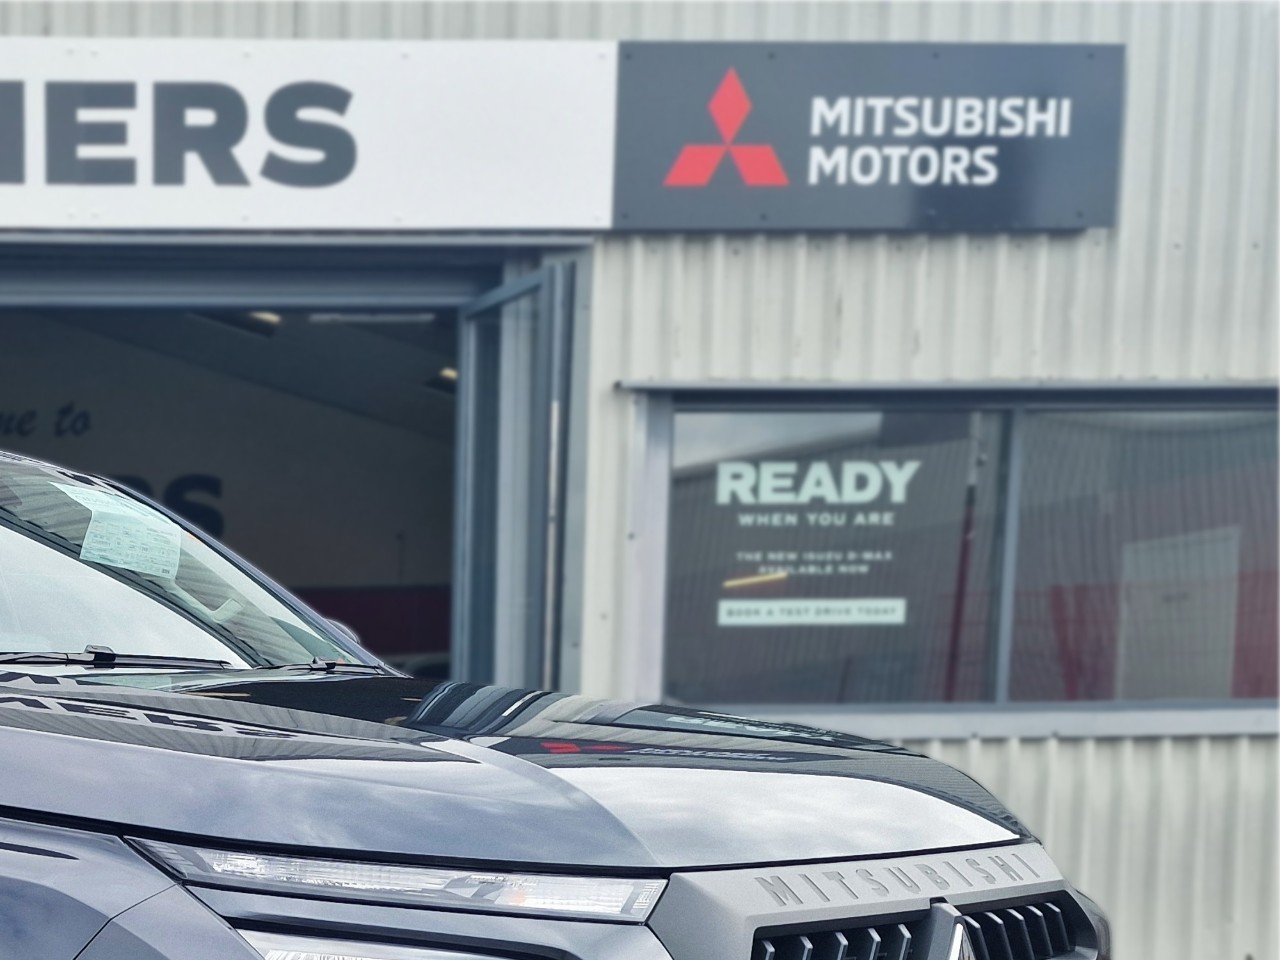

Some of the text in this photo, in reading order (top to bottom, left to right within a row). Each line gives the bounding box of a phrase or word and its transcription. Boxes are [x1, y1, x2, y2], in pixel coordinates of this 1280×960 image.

[810, 97, 1071, 137] MITSUBISHI
[808, 145, 1000, 186] MOTORS
[53, 399, 92, 438] to
[717, 461, 921, 504] READY
[738, 511, 895, 526] WHEN YOU ARE
[754, 852, 1041, 907] MITSUBISHI
